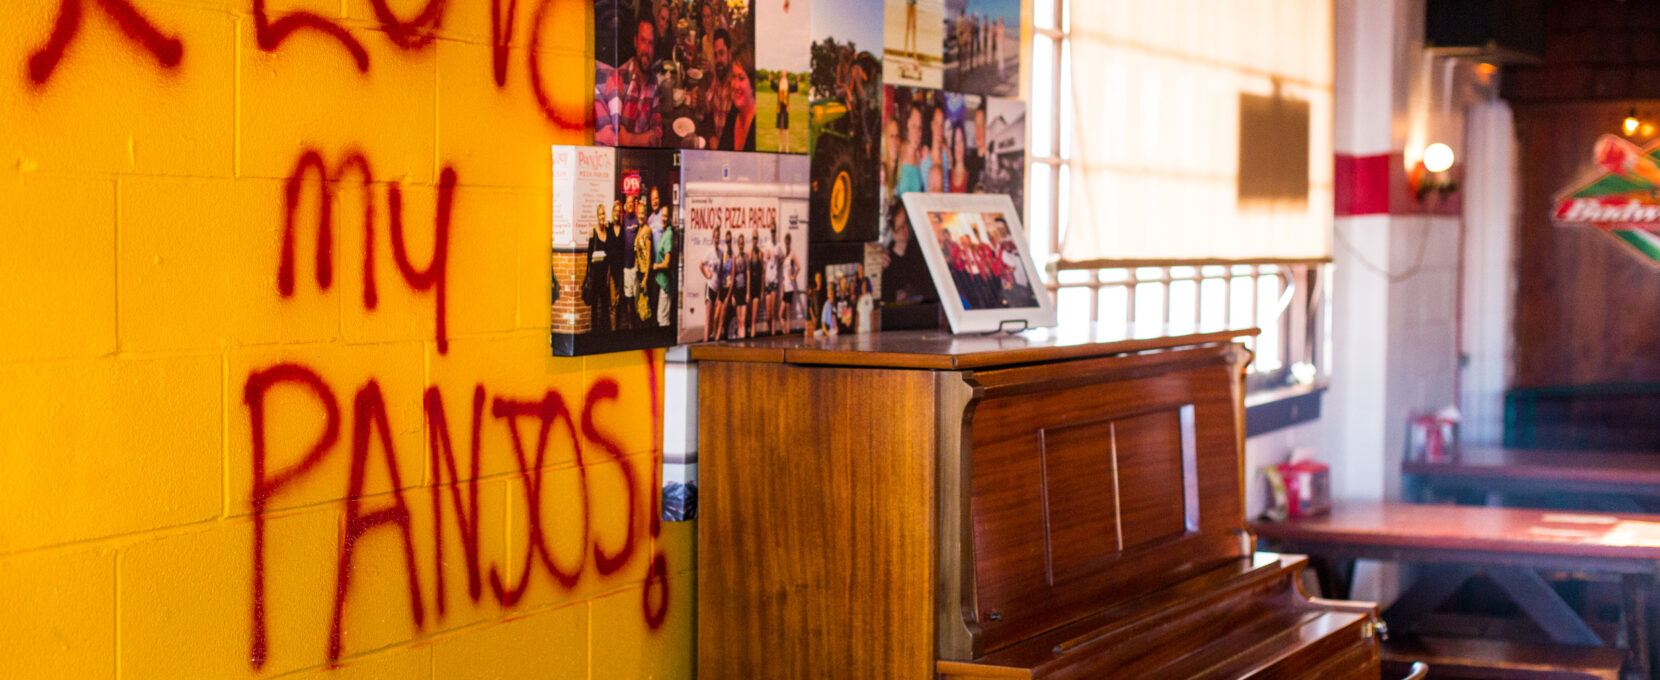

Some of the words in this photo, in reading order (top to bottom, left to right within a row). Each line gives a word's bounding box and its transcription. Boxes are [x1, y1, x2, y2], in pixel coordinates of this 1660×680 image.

[690, 207, 722, 230] PANJO'S
[724, 207, 746, 230] PIZZA
[748, 207, 777, 229] PARLOR
